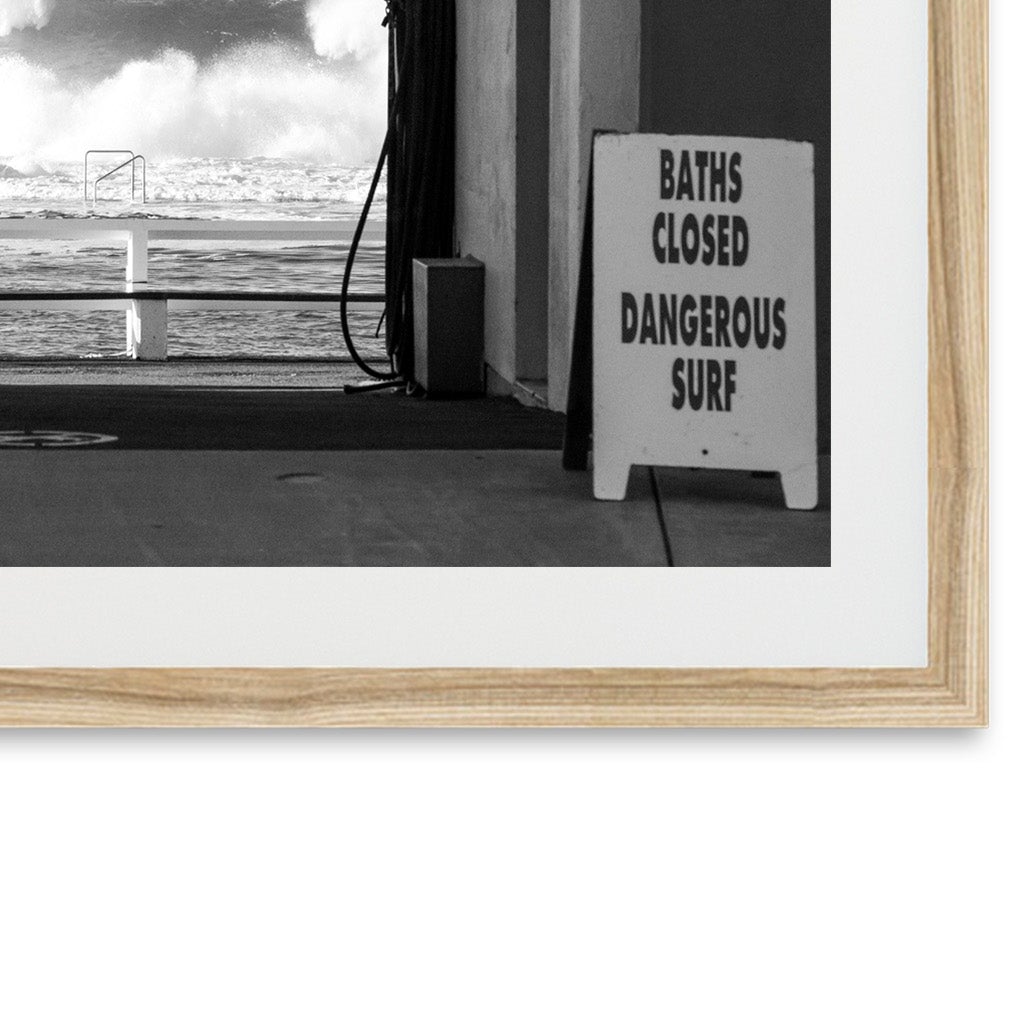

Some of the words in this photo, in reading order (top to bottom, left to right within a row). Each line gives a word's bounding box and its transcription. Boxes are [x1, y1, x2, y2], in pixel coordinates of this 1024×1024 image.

[659, 148, 743, 204] BATHS
[651, 211, 750, 267] CLOSED
[621, 291, 787, 351] DANGEROUS
[671, 357, 737, 413] SURF
